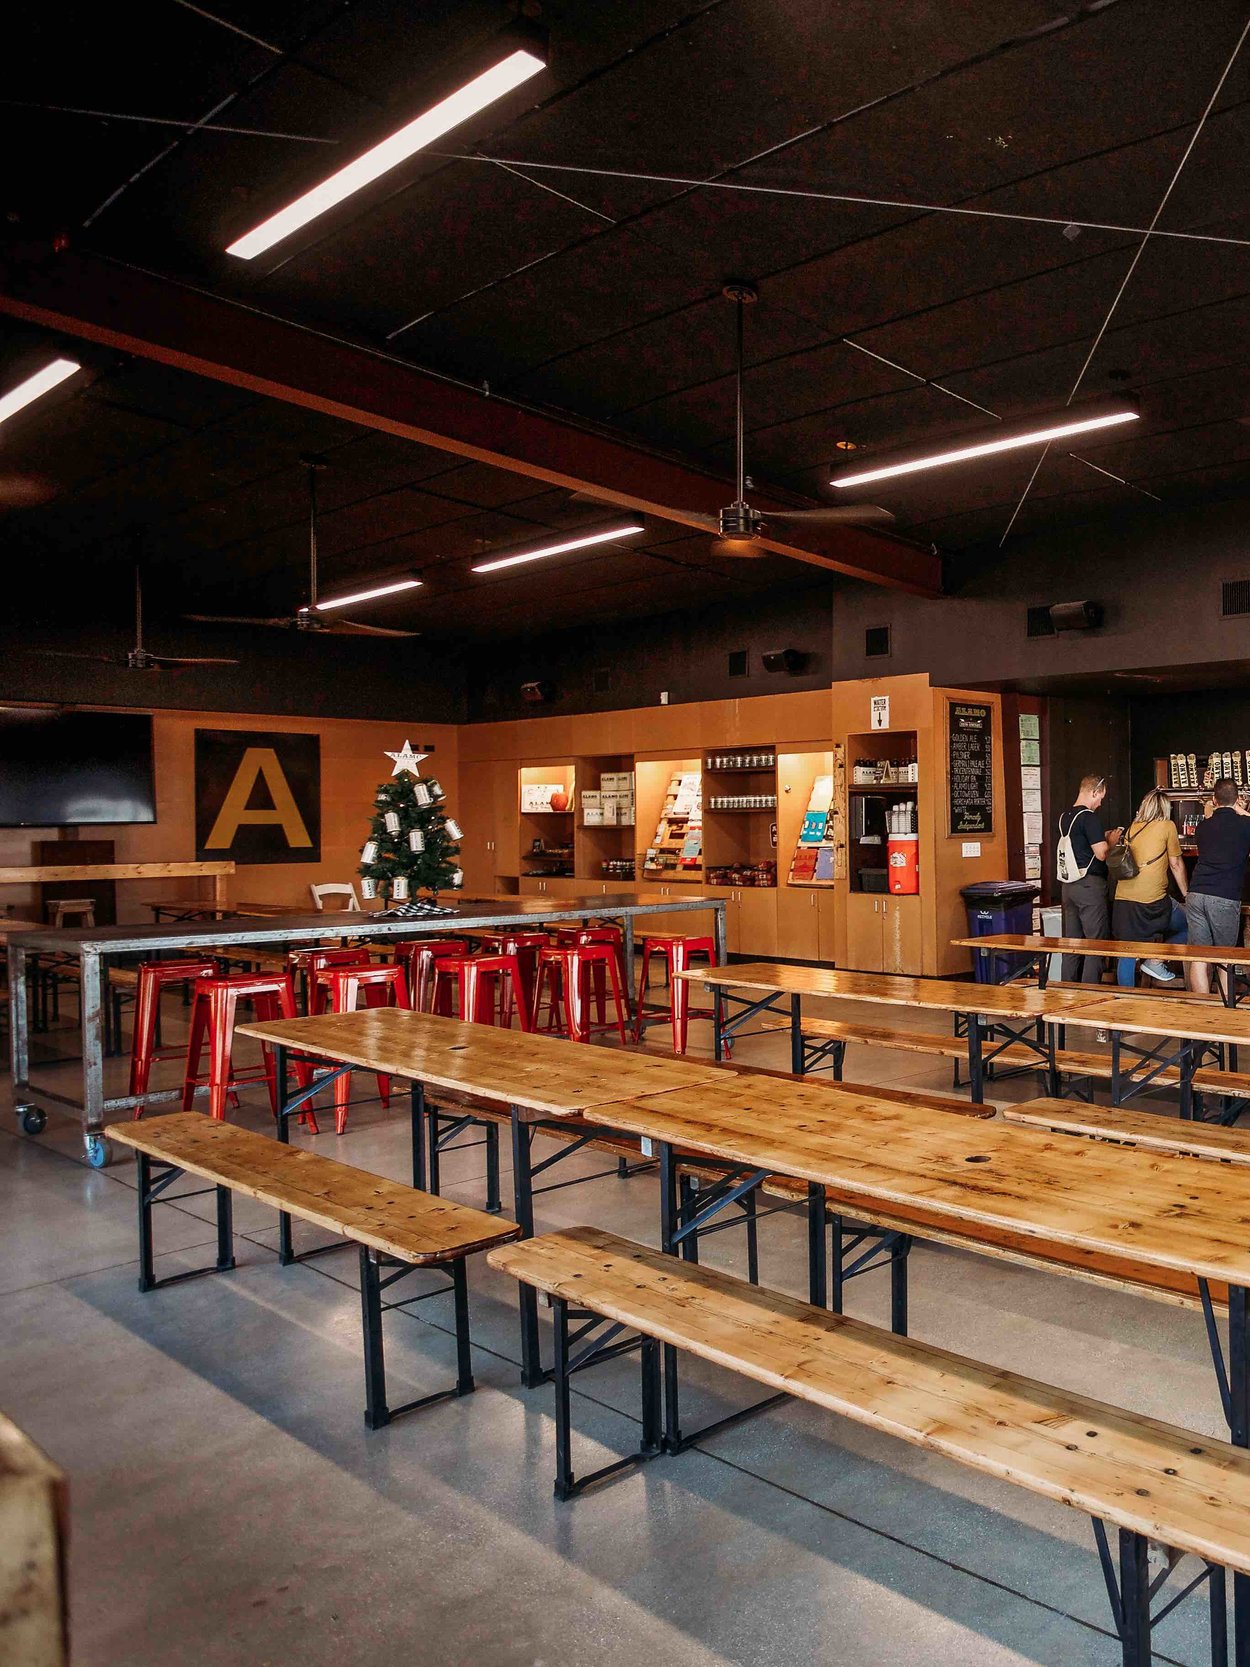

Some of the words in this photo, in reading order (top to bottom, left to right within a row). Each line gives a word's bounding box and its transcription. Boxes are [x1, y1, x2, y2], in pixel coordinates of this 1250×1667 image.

[955, 706, 987, 717] ALAMO
[1180, 763, 1188, 784] ALAMO
[204, 747, 314, 850] A
